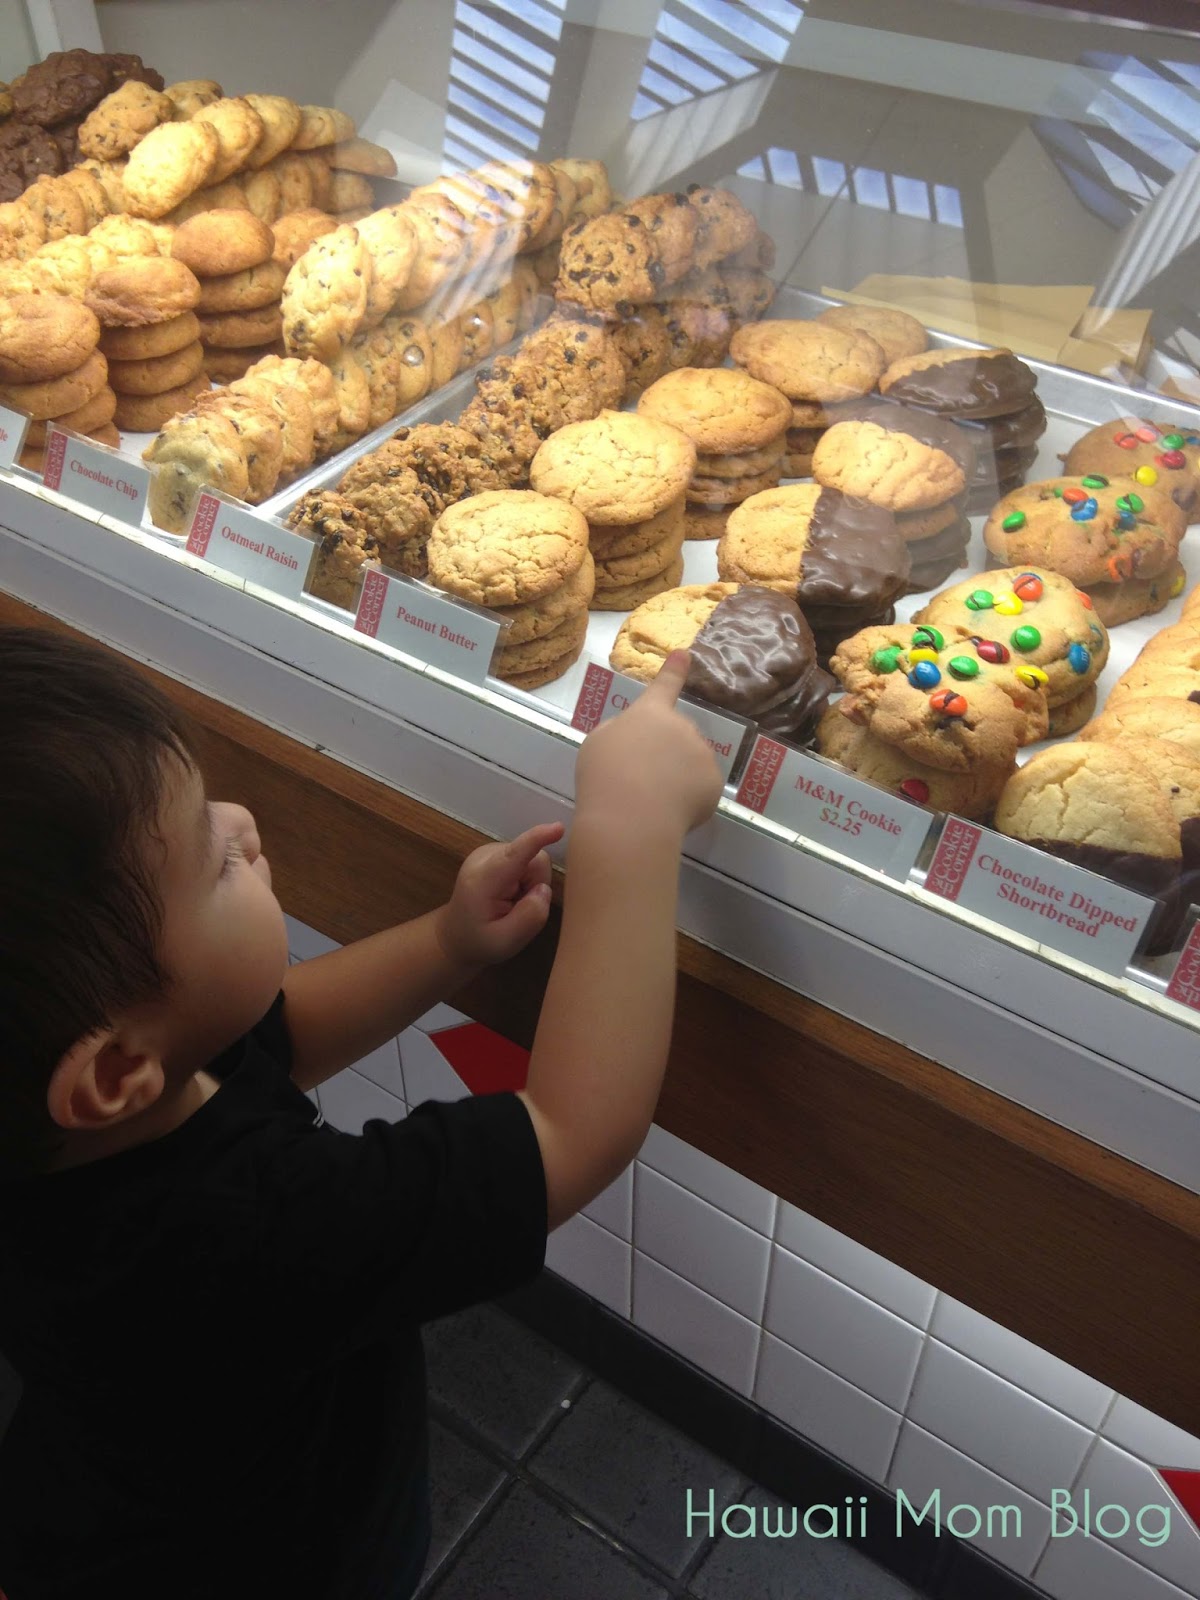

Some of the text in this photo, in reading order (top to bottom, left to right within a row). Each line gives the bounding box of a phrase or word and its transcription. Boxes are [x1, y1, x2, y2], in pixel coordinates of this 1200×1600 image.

[70, 459, 139, 500] Chocolate Chip
[192, 499, 210, 541] Cookie
[199, 500, 216, 544] Corner
[221, 526, 299, 571] Oatmeal Raisin
[360, 575, 377, 621] Cookie
[368, 576, 384, 624] Corner
[397, 606, 478, 652] Peanut Butter
[578, 669, 600, 718] Cookie
[587, 672, 608, 721] Corner
[745, 743, 771, 793] Cookie
[754, 747, 780, 798] Corner
[794, 775, 902, 836] M&M Cookie
[819, 807, 862, 837] $2.25
[934, 825, 964, 879] Cookie
[946, 827, 975, 884] Corner
[977, 853, 1137, 933] Chocolate Dipped
[996, 883, 1101, 938] Shortbread
